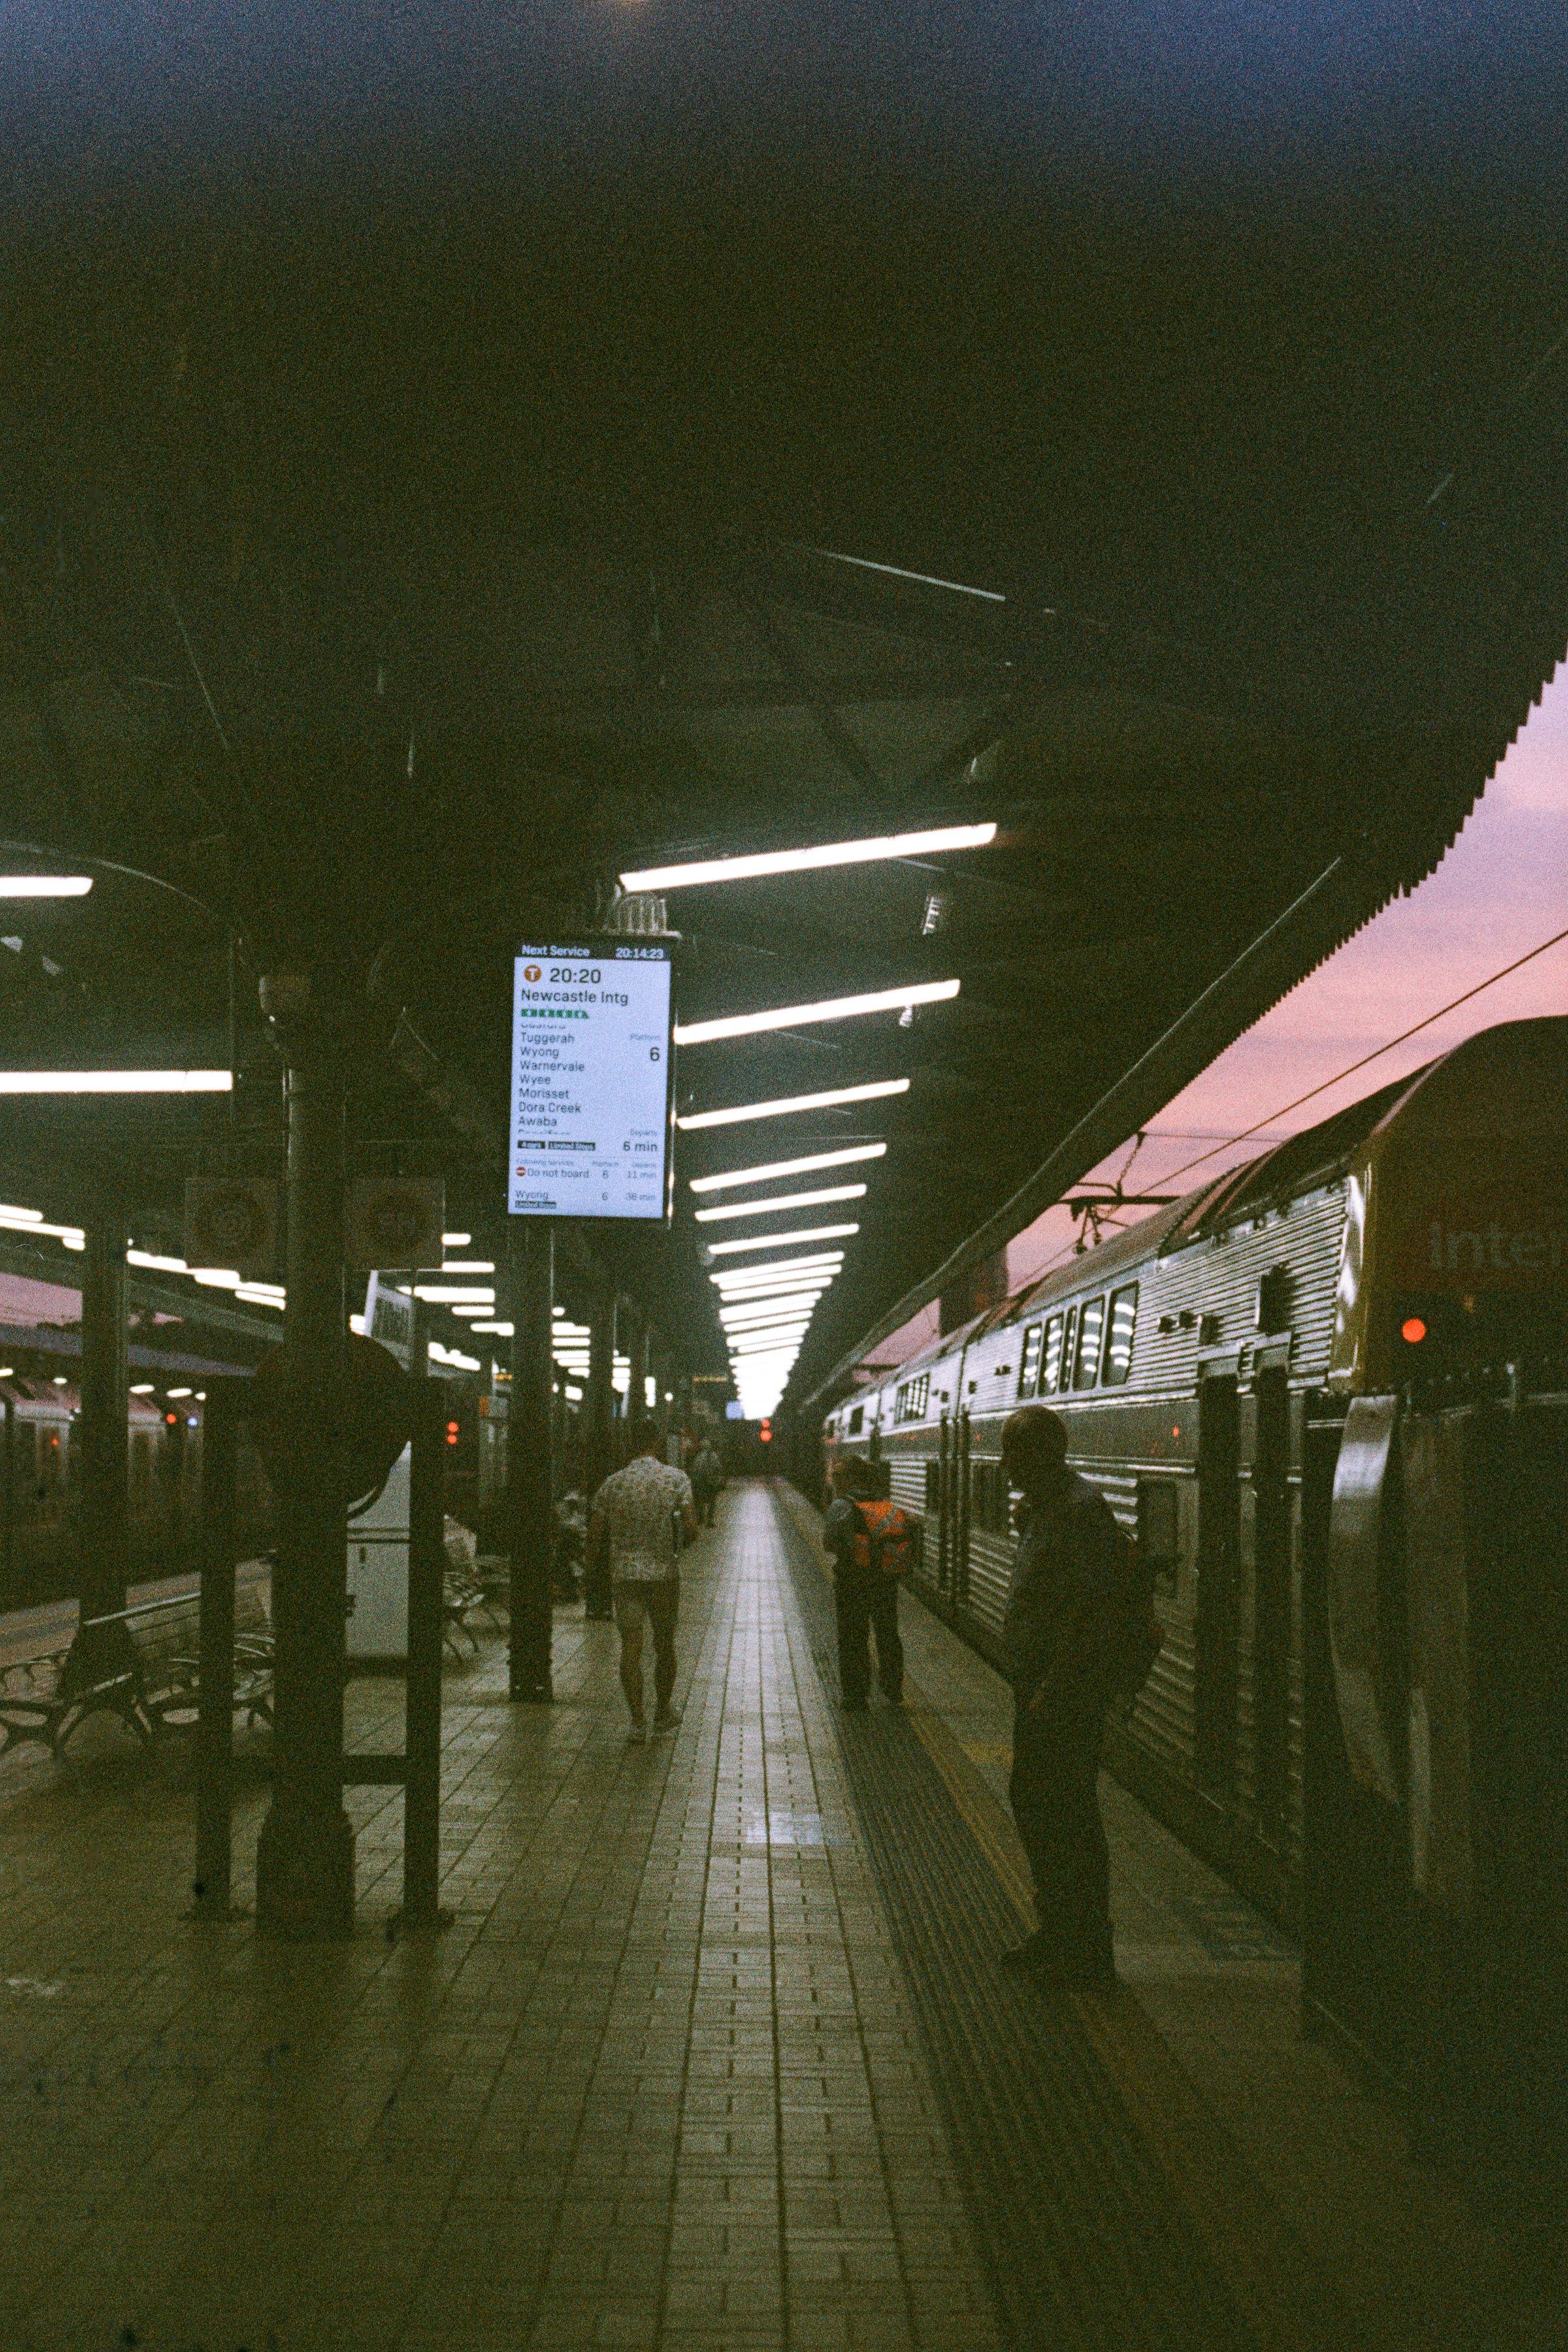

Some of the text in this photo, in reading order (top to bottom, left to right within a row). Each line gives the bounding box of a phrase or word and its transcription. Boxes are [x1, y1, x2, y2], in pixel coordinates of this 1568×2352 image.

[521, 945, 590, 957] Next Service
[615, 947, 664, 959] 20:14:23
[550, 968, 601, 984] 20:20
[521, 989, 629, 1006] Newcastle Intg
[521, 1032, 575, 1045] Tuggerah
[520, 1047, 559, 1059] Wyong
[649, 1047, 660, 1062] 6
[520, 1060, 585, 1072] Warnervale
[519, 1073, 551, 1085] Wyee
[519, 1087, 569, 1100] Morisset
[519, 1102, 581, 1113] Dora Creek
[518, 1116, 557, 1126] Awaba
[623, 1141, 658, 1152] 6 min
[527, 1168, 590, 1179] Do not board
[627, 1170, 637, 1179] 11
[515, 1190, 549, 1201] Wyong
[602, 1192, 608, 1201] 6
